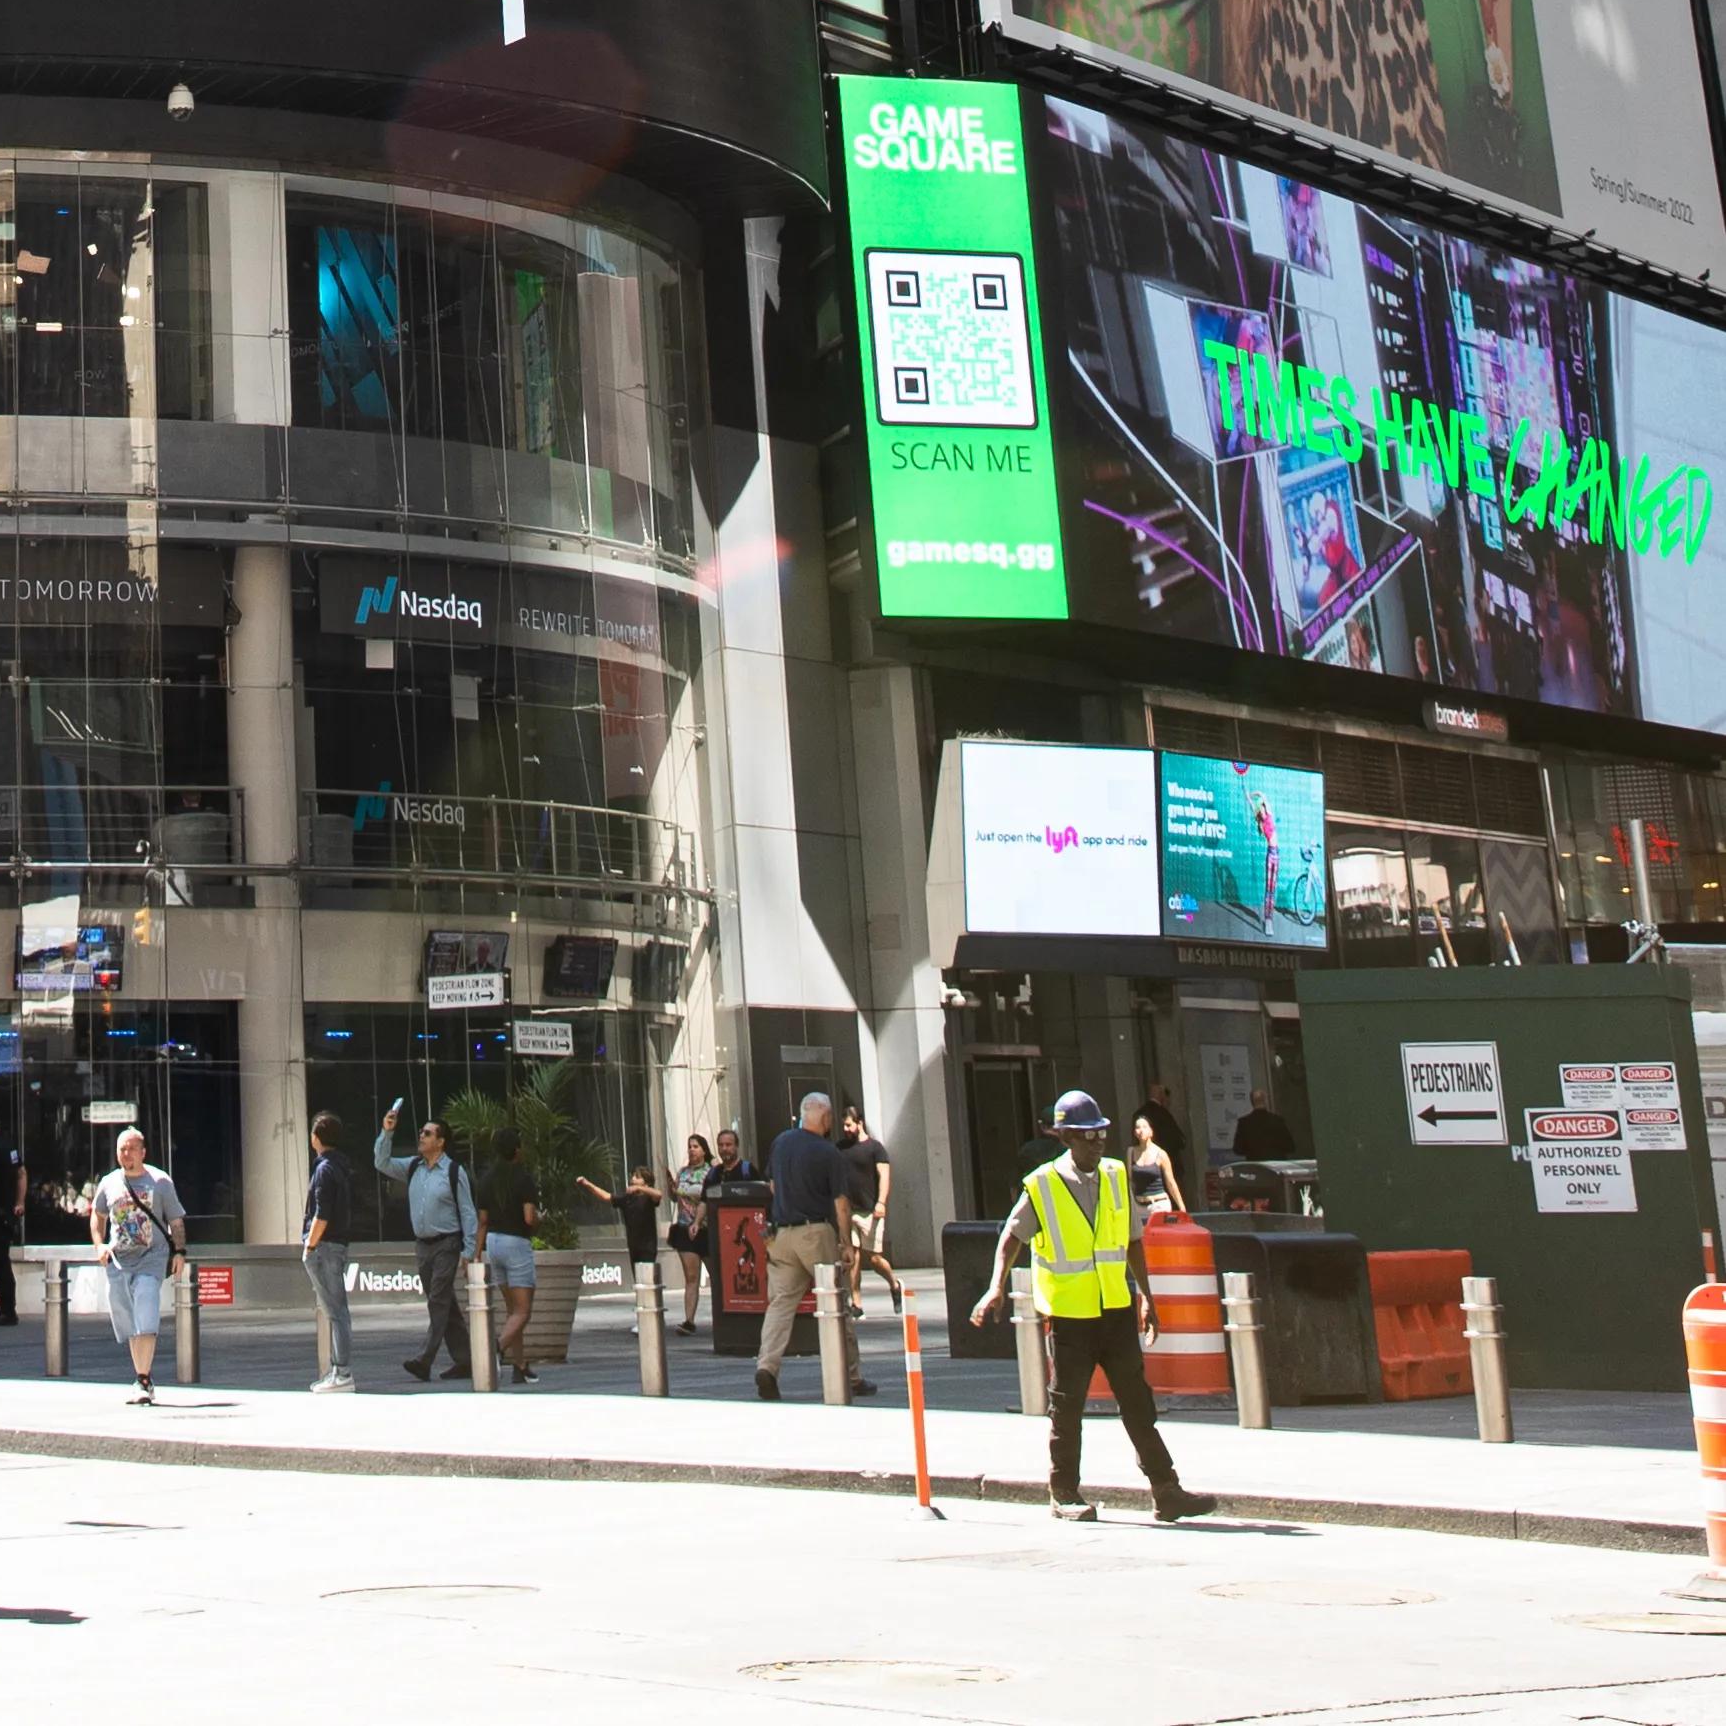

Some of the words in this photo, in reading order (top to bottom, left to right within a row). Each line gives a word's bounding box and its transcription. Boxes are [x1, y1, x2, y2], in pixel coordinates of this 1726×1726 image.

[868, 102, 986, 141] GAME
[853, 134, 1017, 175] SQUARE
[1590, 167, 1667, 215] Spring/Summer
[1668, 197, 1695, 225] 2022
[891, 441, 975, 473] SCAN
[986, 444, 1033, 474] ME
[1204, 339, 1364, 464] TIMES
[1371, 386, 1497, 499] HAVE
[1504, 419, 1714, 567] CHANGED
[887, 537, 1056, 572] gamesq.gg
[400, 590, 482, 629] Nasdaq
[520, 607, 590, 637] REWRITE
[394, 796, 465, 832] Nasdaq
[975, 830, 994, 842] Just
[997, 832, 1023, 844] open
[1026, 830, 1042, 843] the
[1046, 825, 1079, 853] lyft
[1083, 835, 1103, 847] app
[1106, 835, 1124, 846] and
[1128, 835, 1148, 846] ride
[432, 979, 464, 990] PEDESTRIAN
[465, 979, 480, 989] FLOW
[481, 978, 494, 988] ZONE
[432, 993, 445, 1002] KEEP
[447, 992, 467, 1002] MOVING
[519, 1026, 545, 1037] PEDESTRIAN
[1410, 1062, 1493, 1093] PEDESTRIANS
[1570, 1068, 1608, 1080] DANGER
[1627, 1068, 1665, 1079] DANGER
[1544, 1119, 1608, 1134] DANGER
[1633, 1111, 1672, 1122] DANGER
[1537, 1146, 1622, 1159] AUTHORIZED
[1543, 1164, 1621, 1176] PERSONNEL
[1567, 1183, 1602, 1194] ONLY
[359, 1270, 424, 1295] Nasdaq
